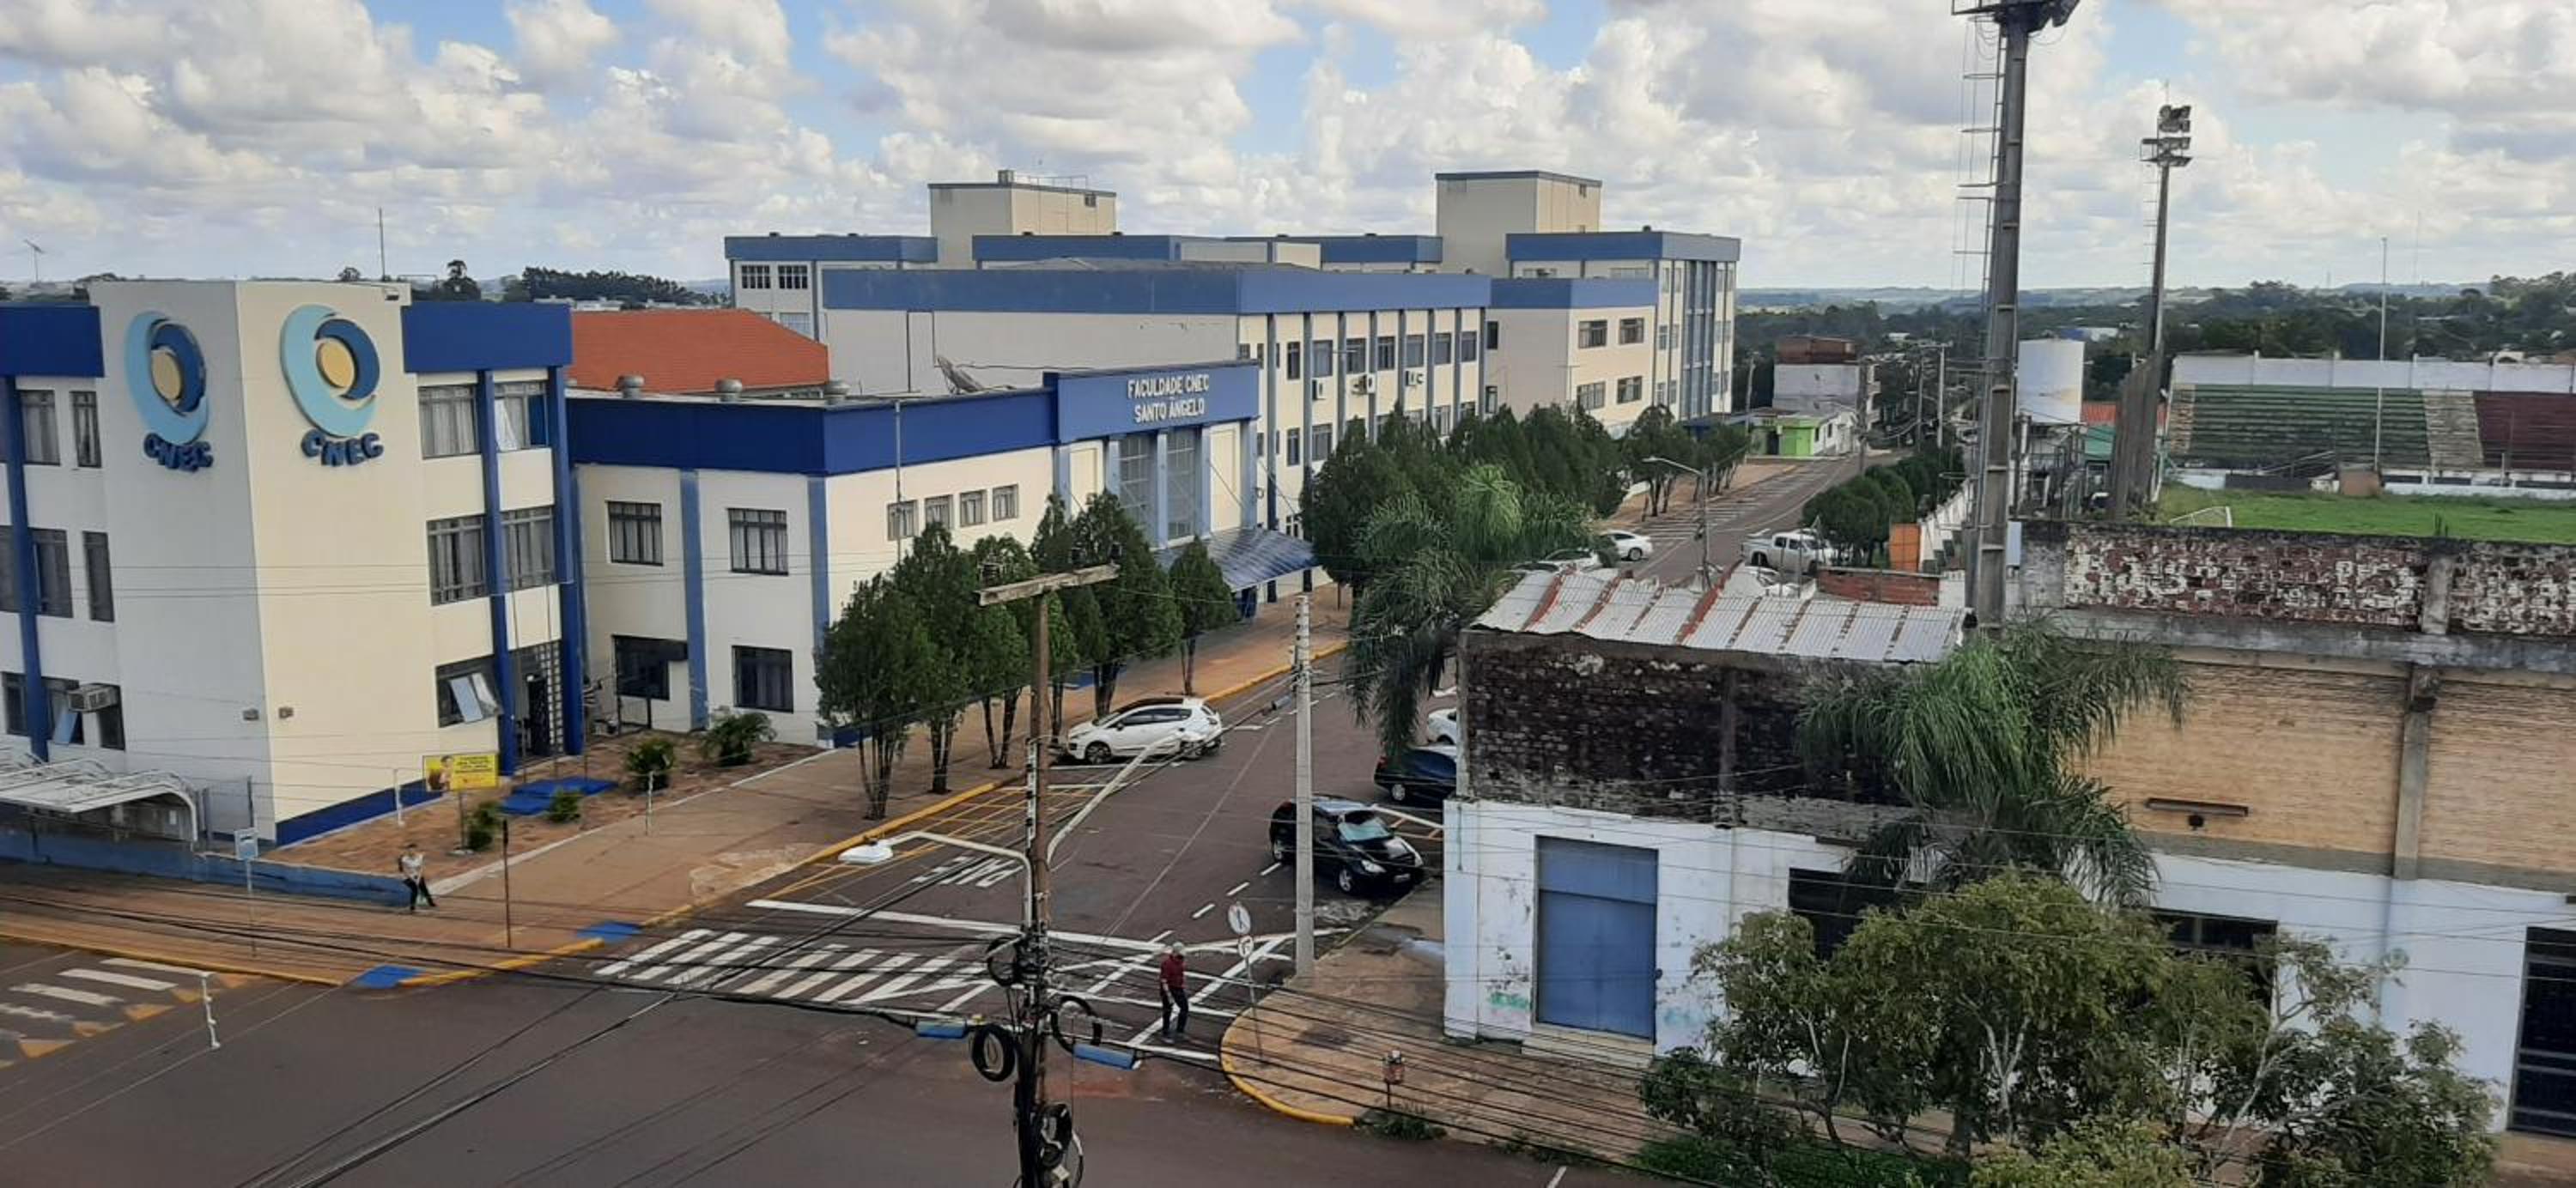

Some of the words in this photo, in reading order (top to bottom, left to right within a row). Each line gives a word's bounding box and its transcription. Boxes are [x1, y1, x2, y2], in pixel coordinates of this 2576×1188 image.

[1127, 376, 1183, 398] FACULDADE
[1186, 374, 1210, 393] CNEC
[1134, 401, 1167, 423] SANTO
[143, 432, 214, 472] CNEC
[301, 429, 384, 467] CNEC
